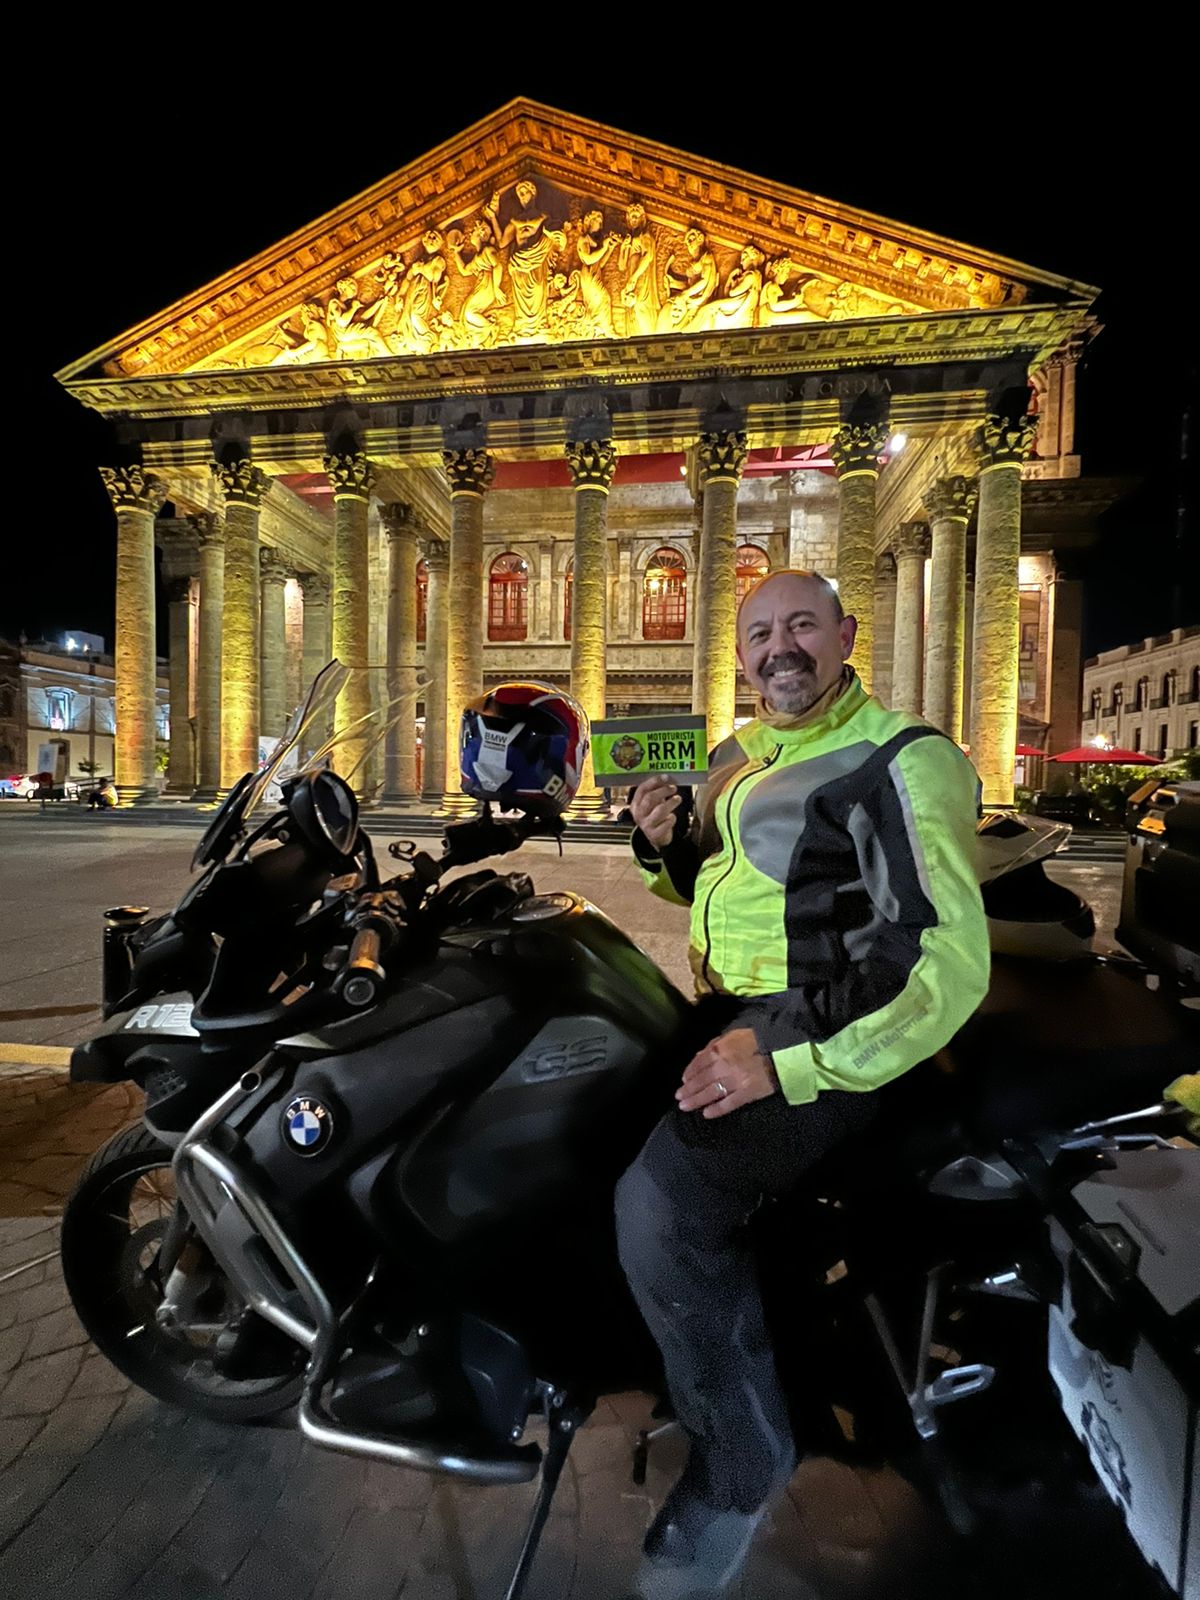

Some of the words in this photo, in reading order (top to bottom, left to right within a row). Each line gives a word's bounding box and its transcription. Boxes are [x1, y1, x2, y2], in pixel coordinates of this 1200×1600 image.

[484, 731, 508, 744] BMW
[647, 731, 695, 741] MOTOTURISTA
[648, 740, 695, 761] RRM
[649, 761, 677, 770] MÉXICO
[852, 1041, 882, 1070] BMW
[286, 1100, 326, 1120] BMW
